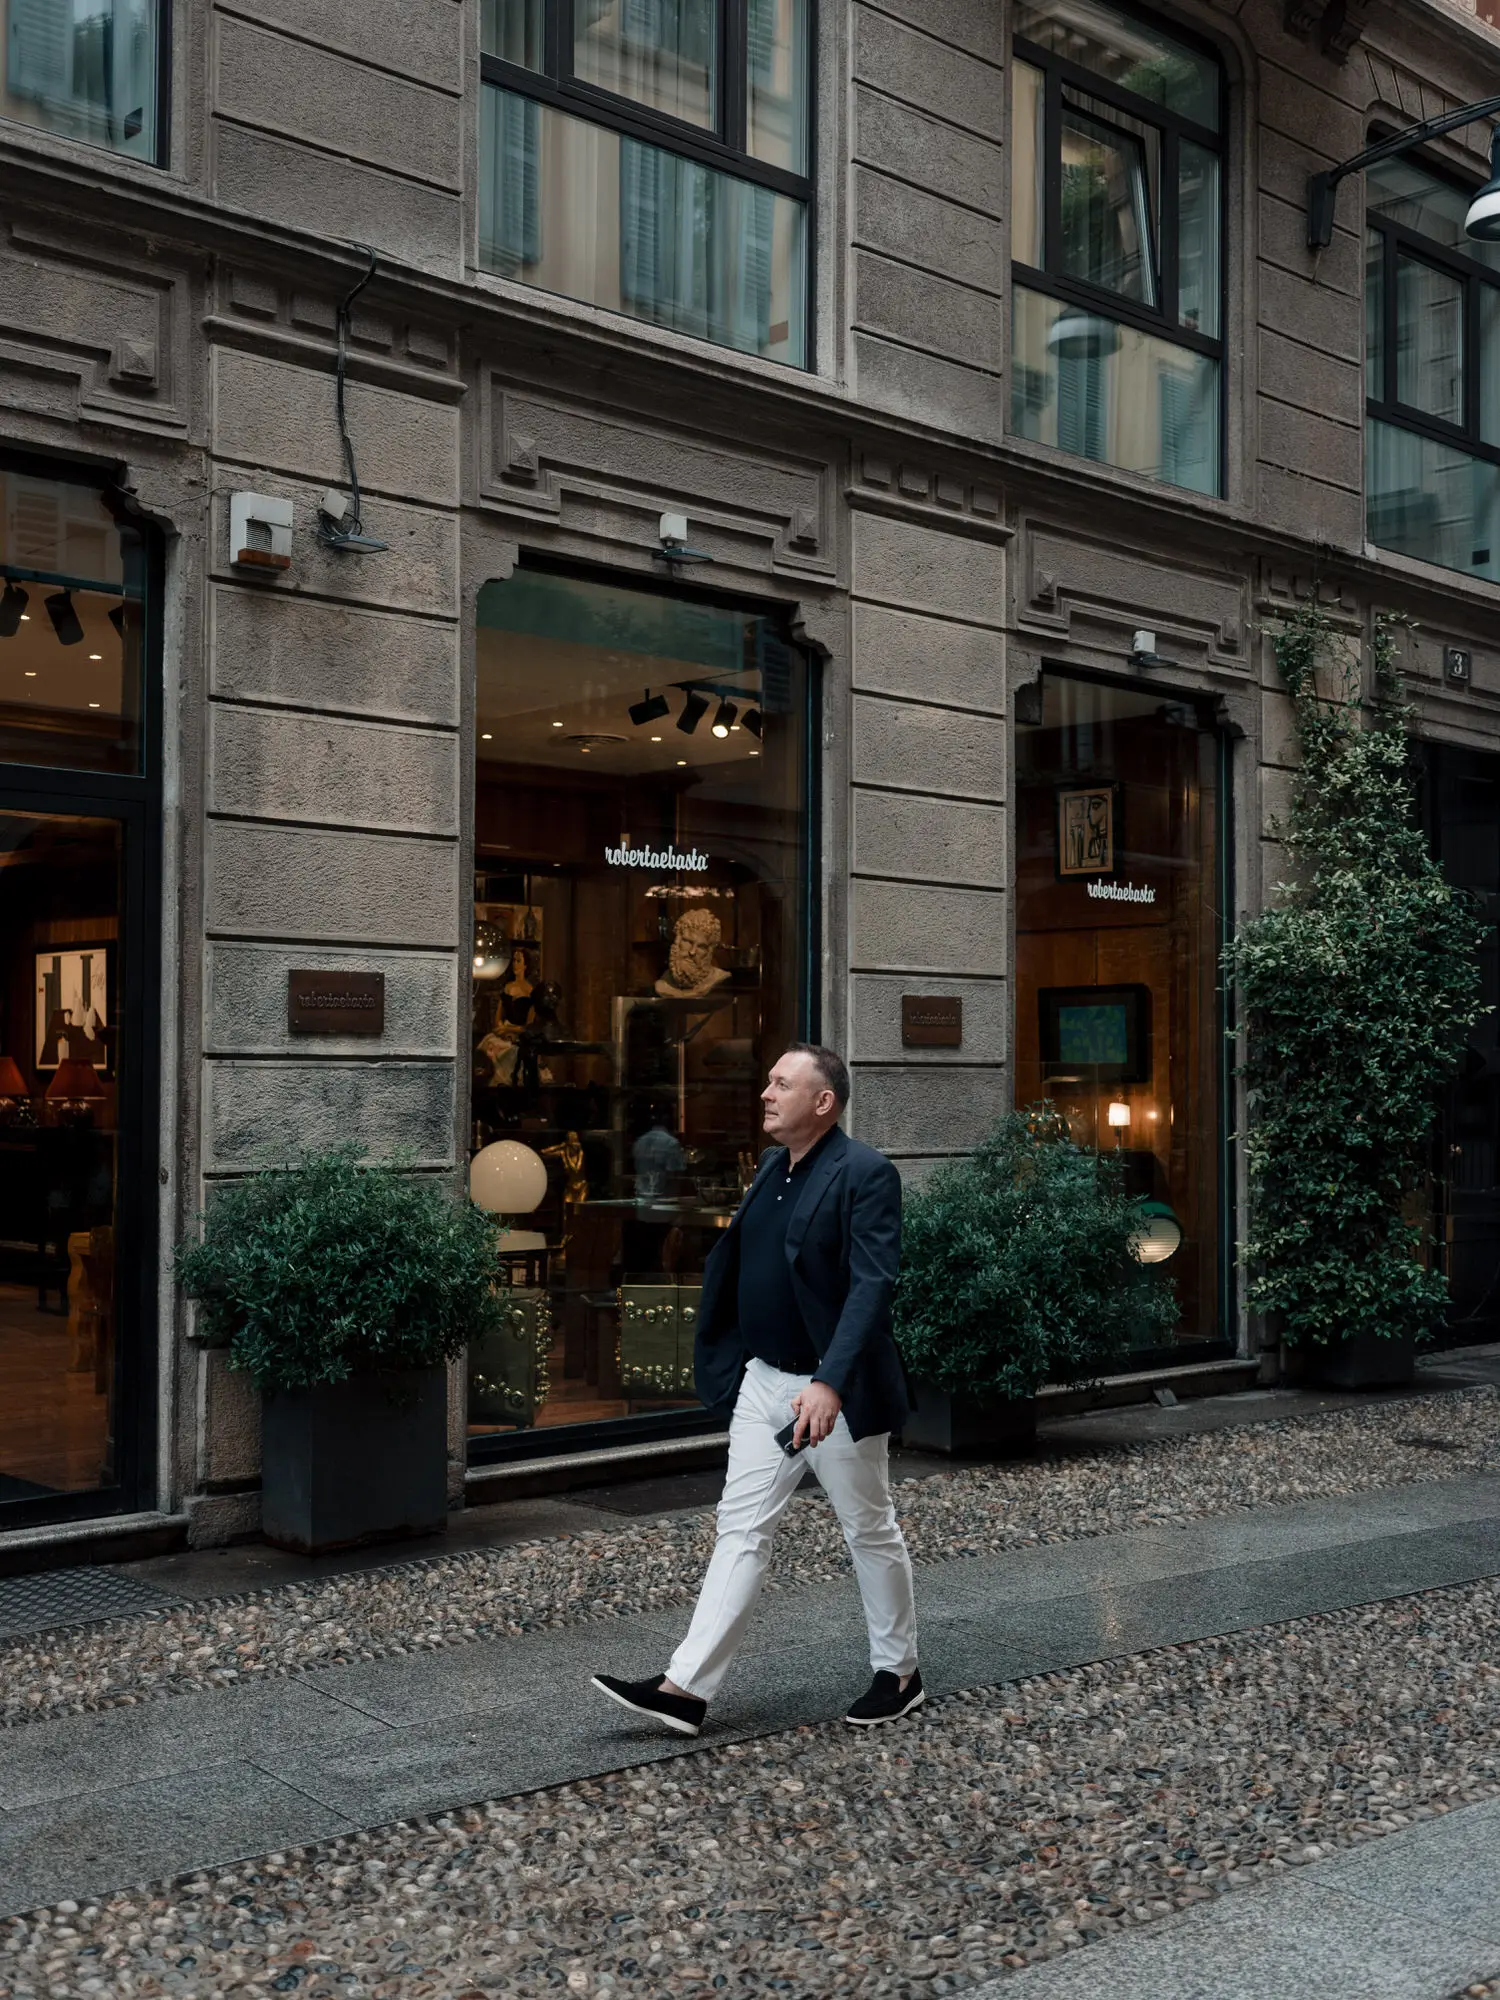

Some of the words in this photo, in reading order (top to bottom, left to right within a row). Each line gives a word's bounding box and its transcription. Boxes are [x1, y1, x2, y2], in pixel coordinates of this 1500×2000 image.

[1454, 653, 1463, 675] 3
[605, 841, 708, 871] robertaebasta
[1087, 878, 1155, 903] robertaebasta
